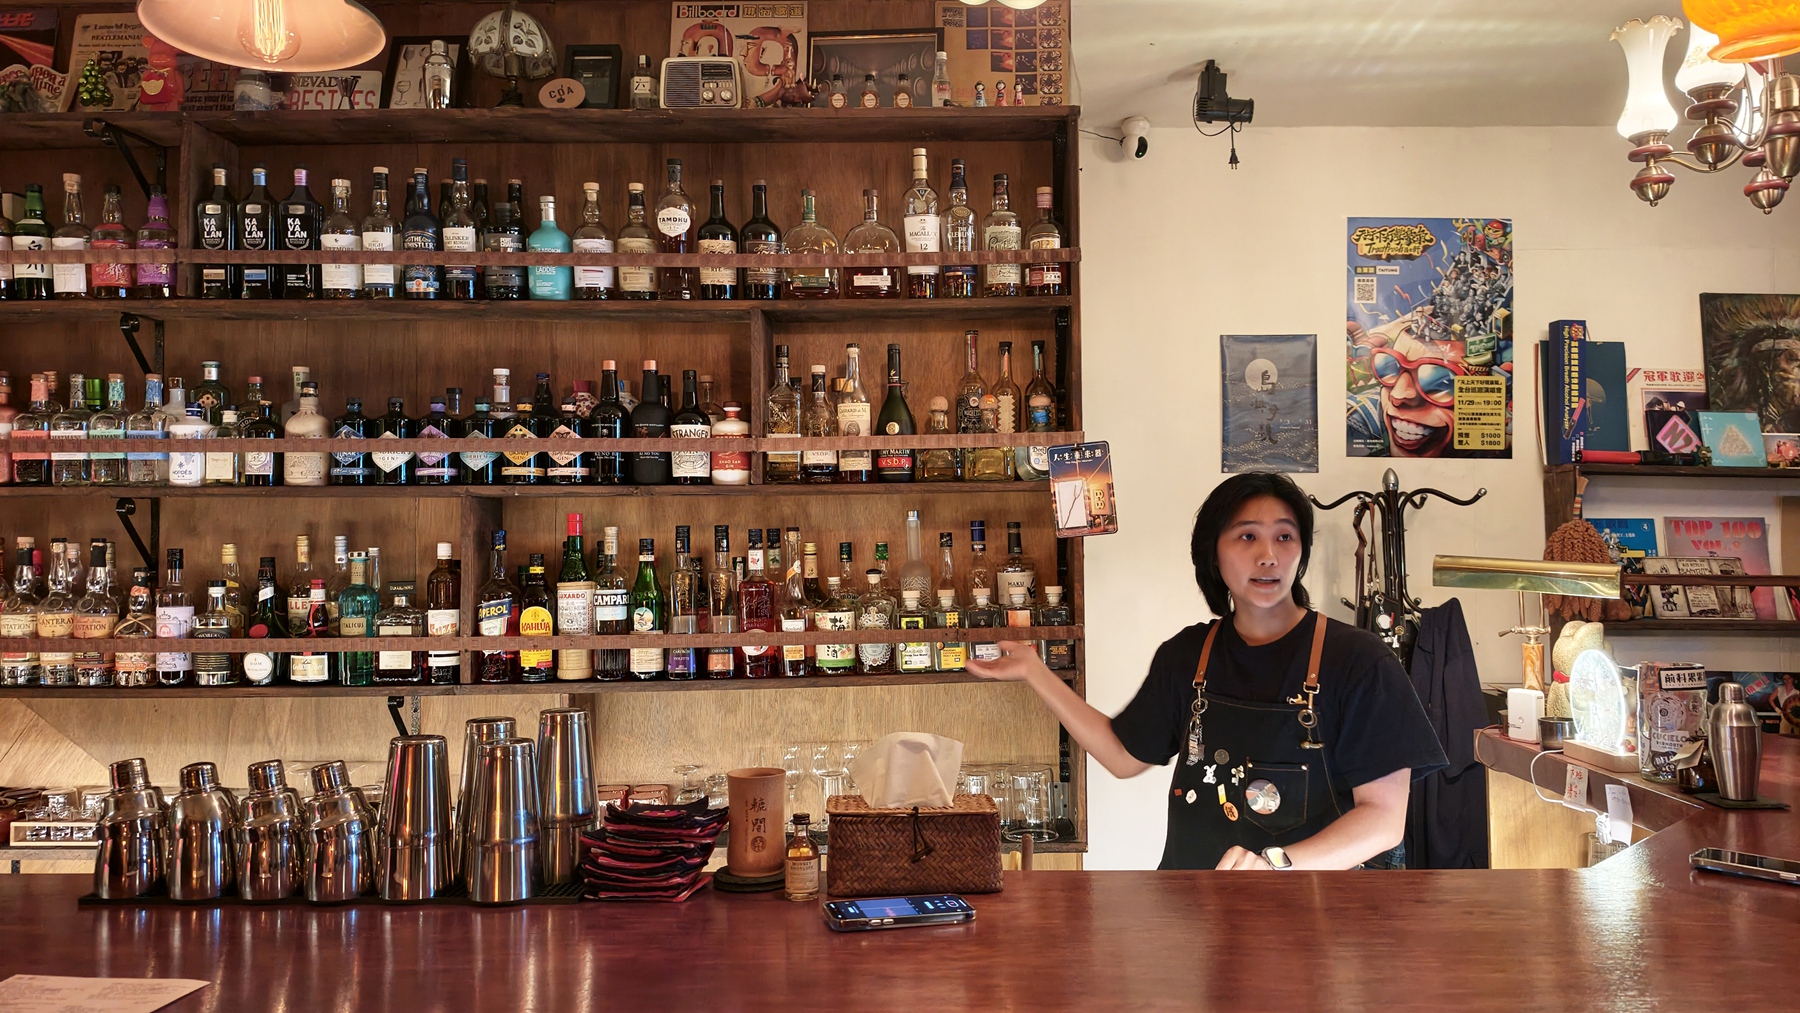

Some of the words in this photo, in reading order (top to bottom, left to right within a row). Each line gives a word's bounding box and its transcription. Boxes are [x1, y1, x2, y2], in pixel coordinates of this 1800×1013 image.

[680, 5, 737, 18] Billboard
[290, 75, 351, 88] NEVAD
[1644, 371, 1695, 382] 冠軍歌選
[672, 428, 710, 438] STRANGER
[1669, 520, 1713, 538] TOP
[1720, 520, 1762, 539] 100
[593, 594, 630, 606] CAMPARI
[478, 605, 508, 620] APEROL
[1665, 672, 1706, 683] 前科累累
